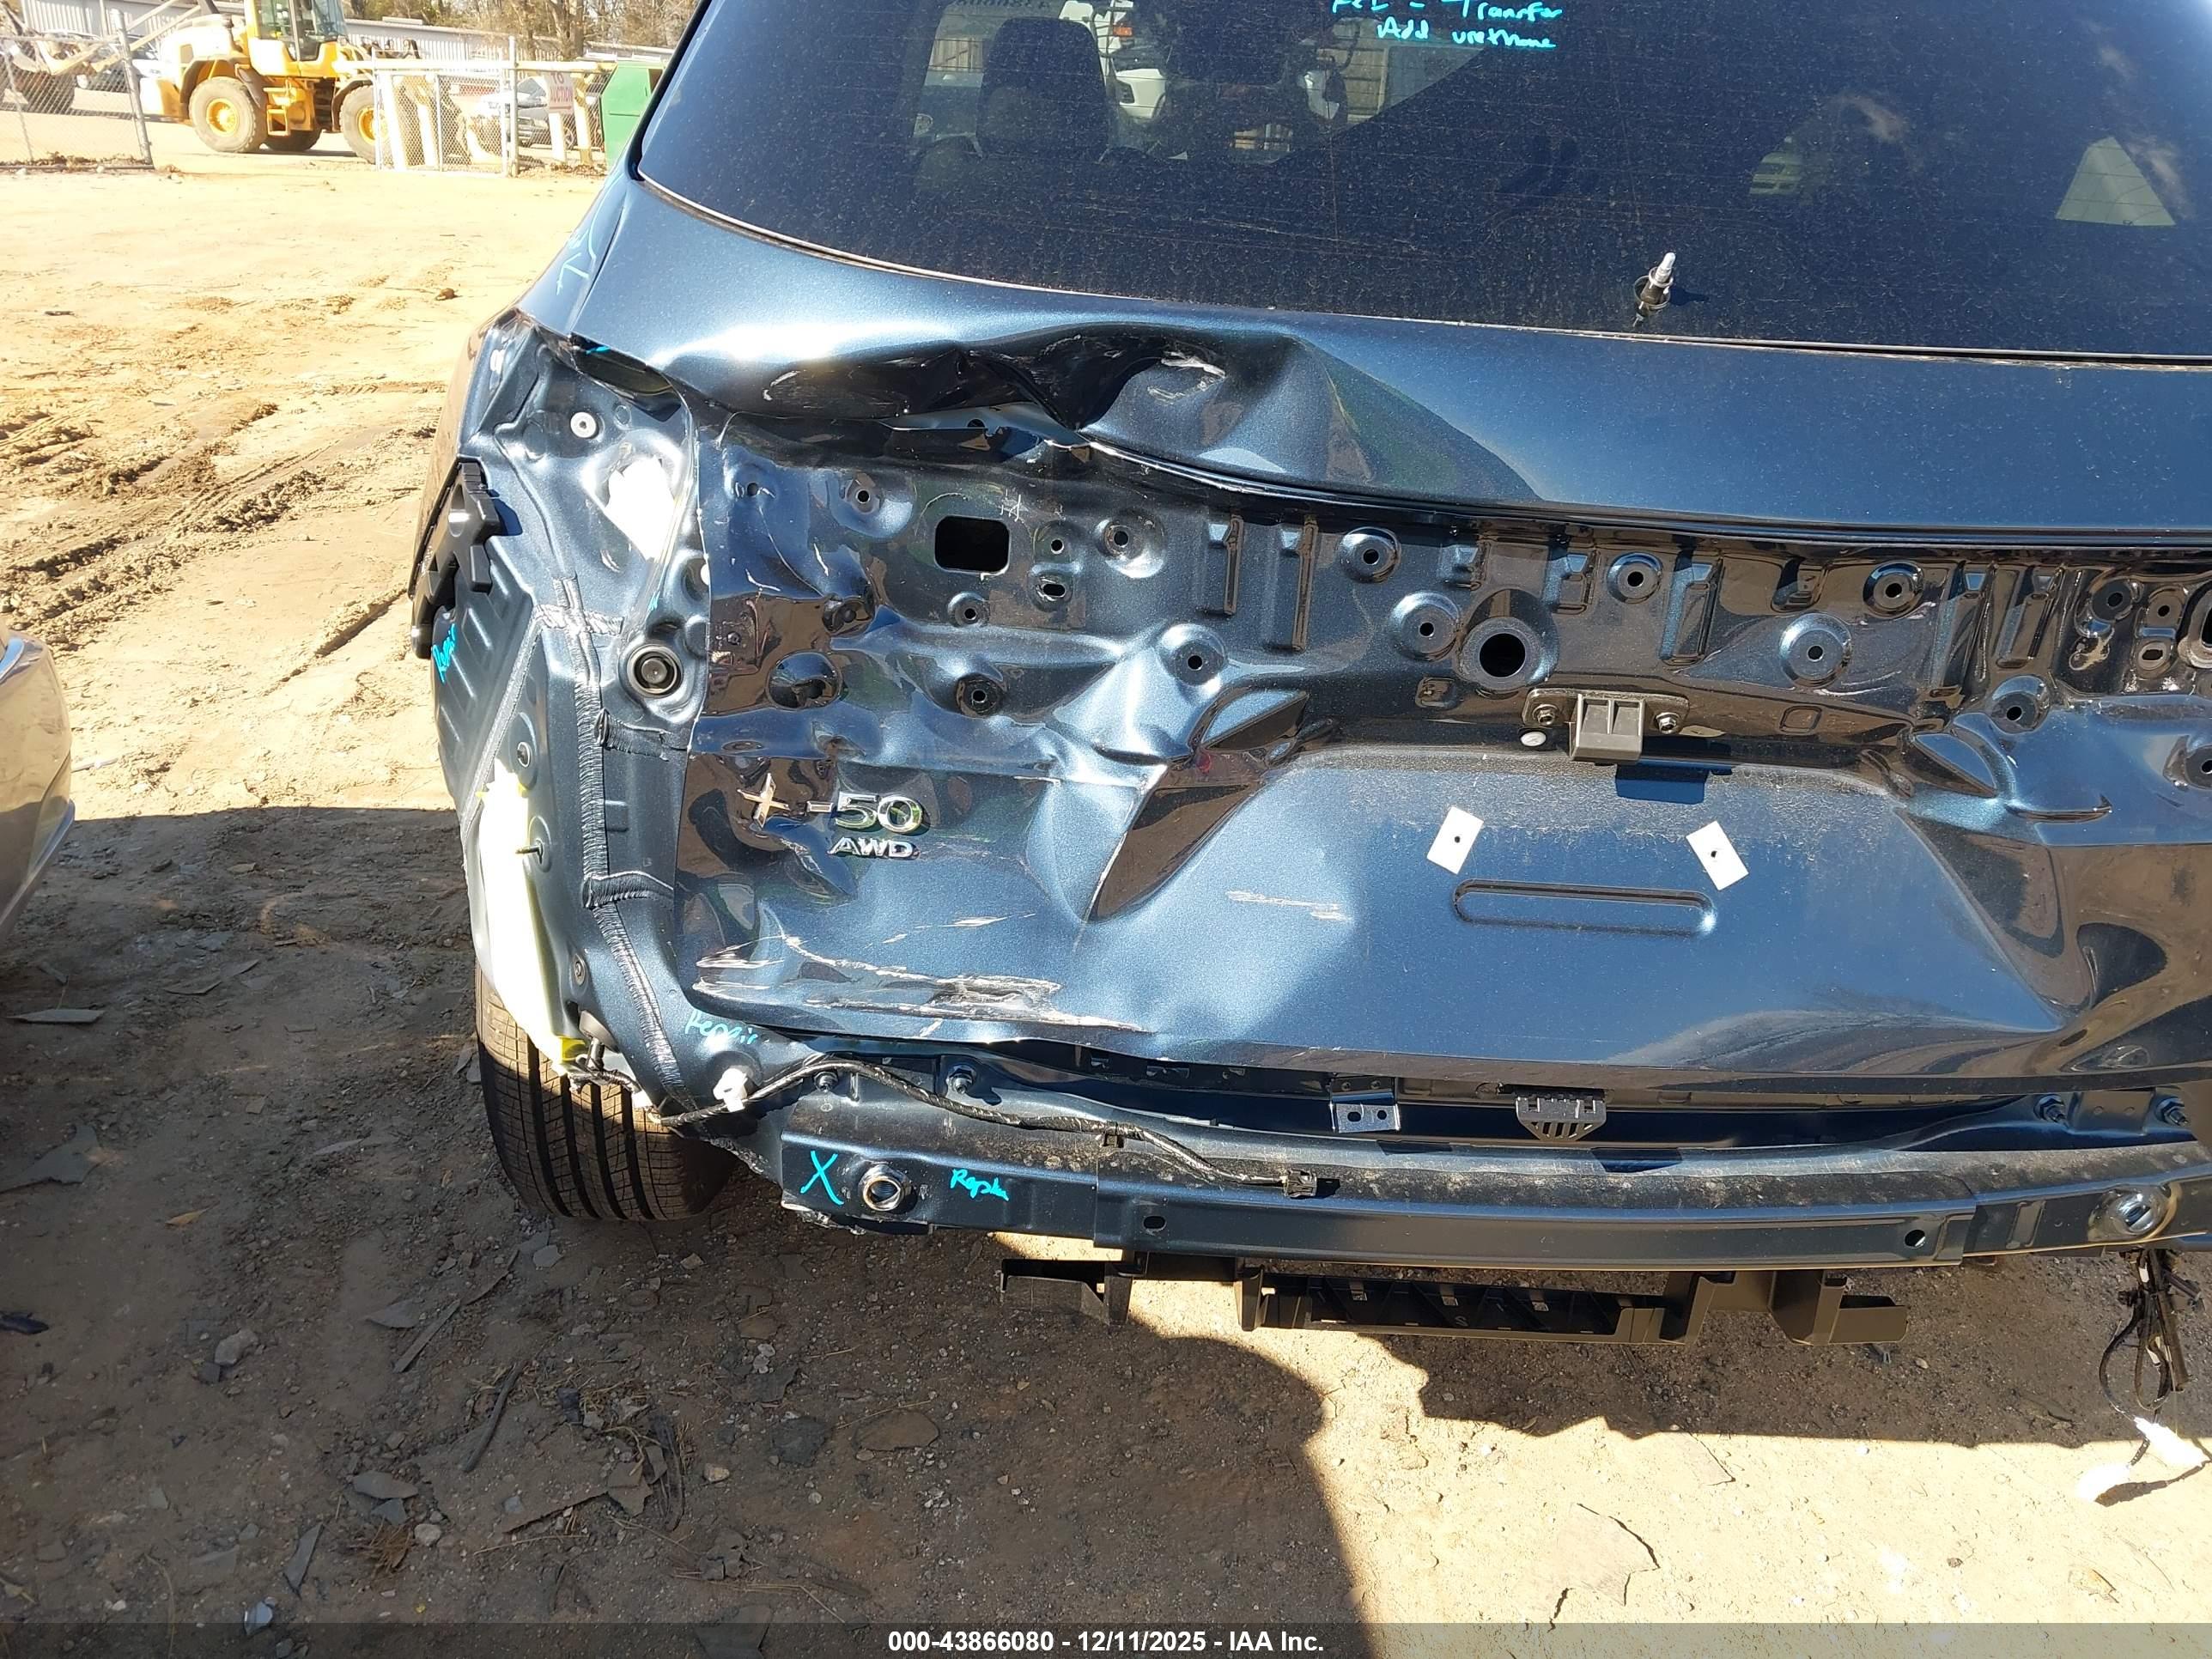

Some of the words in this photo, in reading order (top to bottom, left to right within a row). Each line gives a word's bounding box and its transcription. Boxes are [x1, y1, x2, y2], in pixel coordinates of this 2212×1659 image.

[1376, 16, 1429, 40] Add
[550, 71, 564, 84] TO
[827, 836, 913, 858] AWD
[799, 1151, 845, 1206] X
